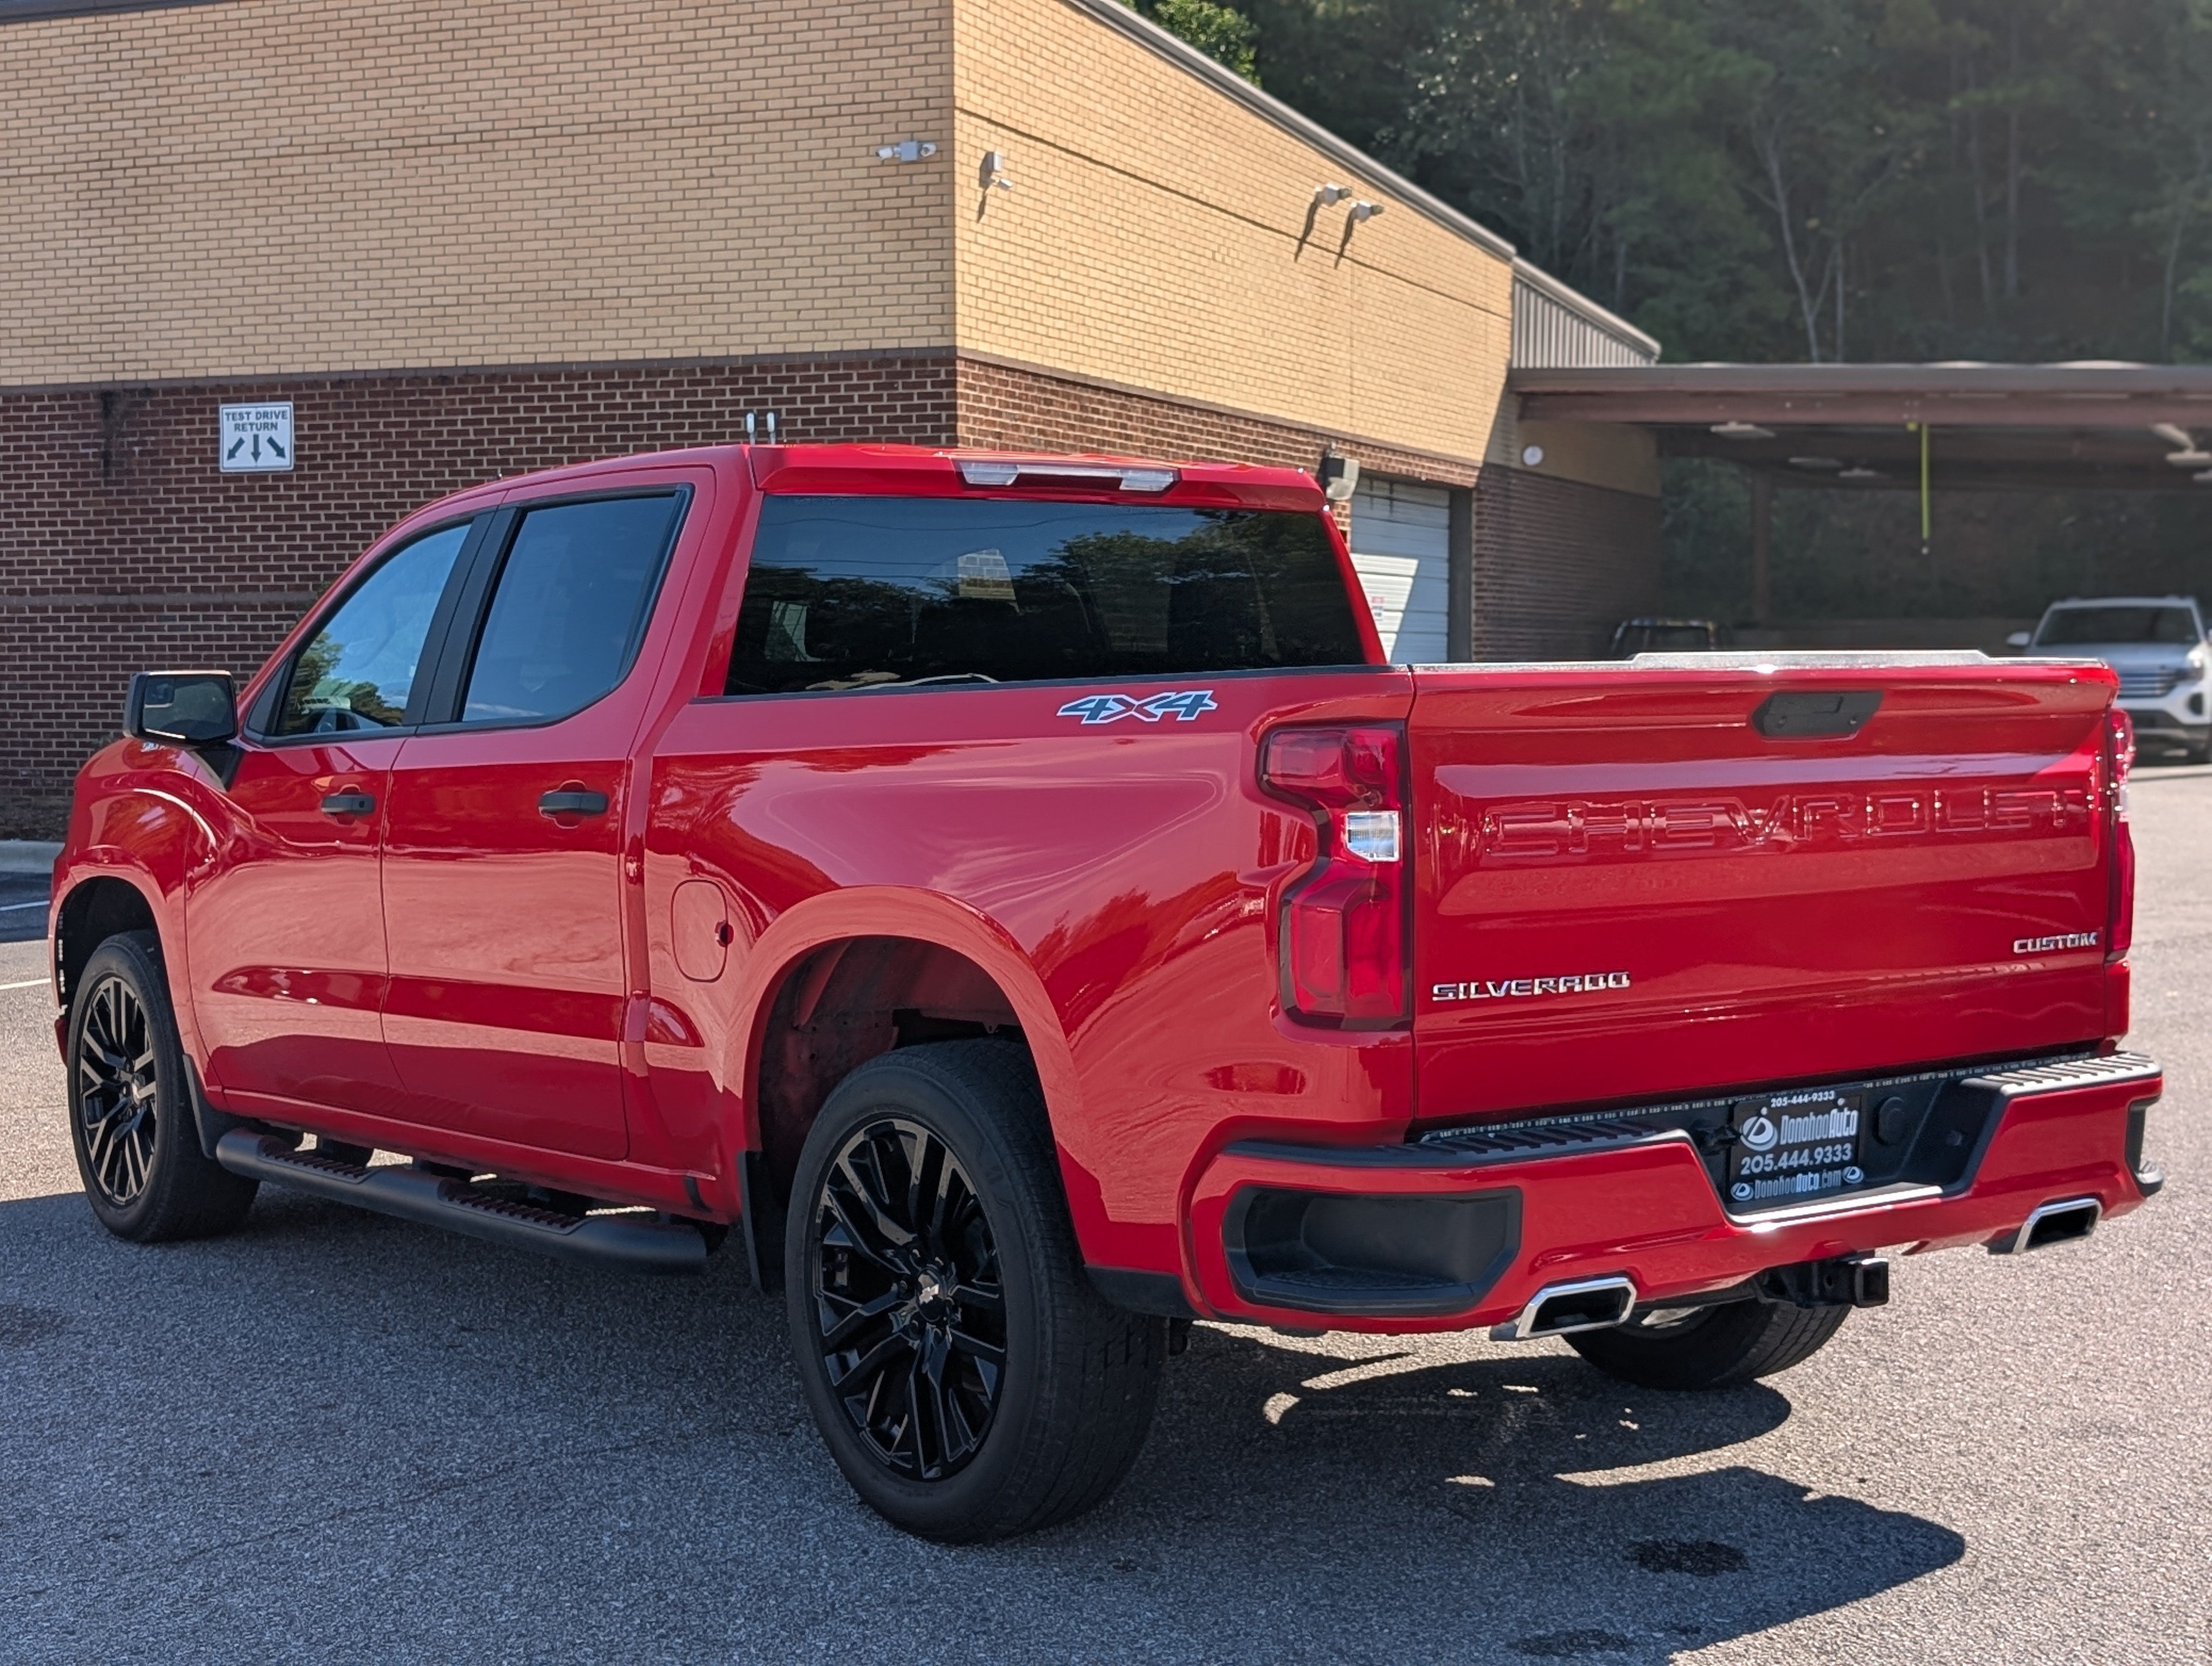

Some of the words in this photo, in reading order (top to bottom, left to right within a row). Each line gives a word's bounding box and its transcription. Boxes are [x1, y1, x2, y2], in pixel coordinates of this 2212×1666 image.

[225, 412, 251, 421] TEST
[255, 410, 287, 420] DRIVE
[234, 422, 278, 432] RETURN
[1484, 785, 2087, 855] CHEVROLET
[2013, 931, 2098, 954] CUSTOM
[1432, 971, 1631, 1001] SILVERADO
[1771, 1090, 1835, 1107] 205-444-9333
[1741, 1143, 1852, 1175] 205.444.9333
